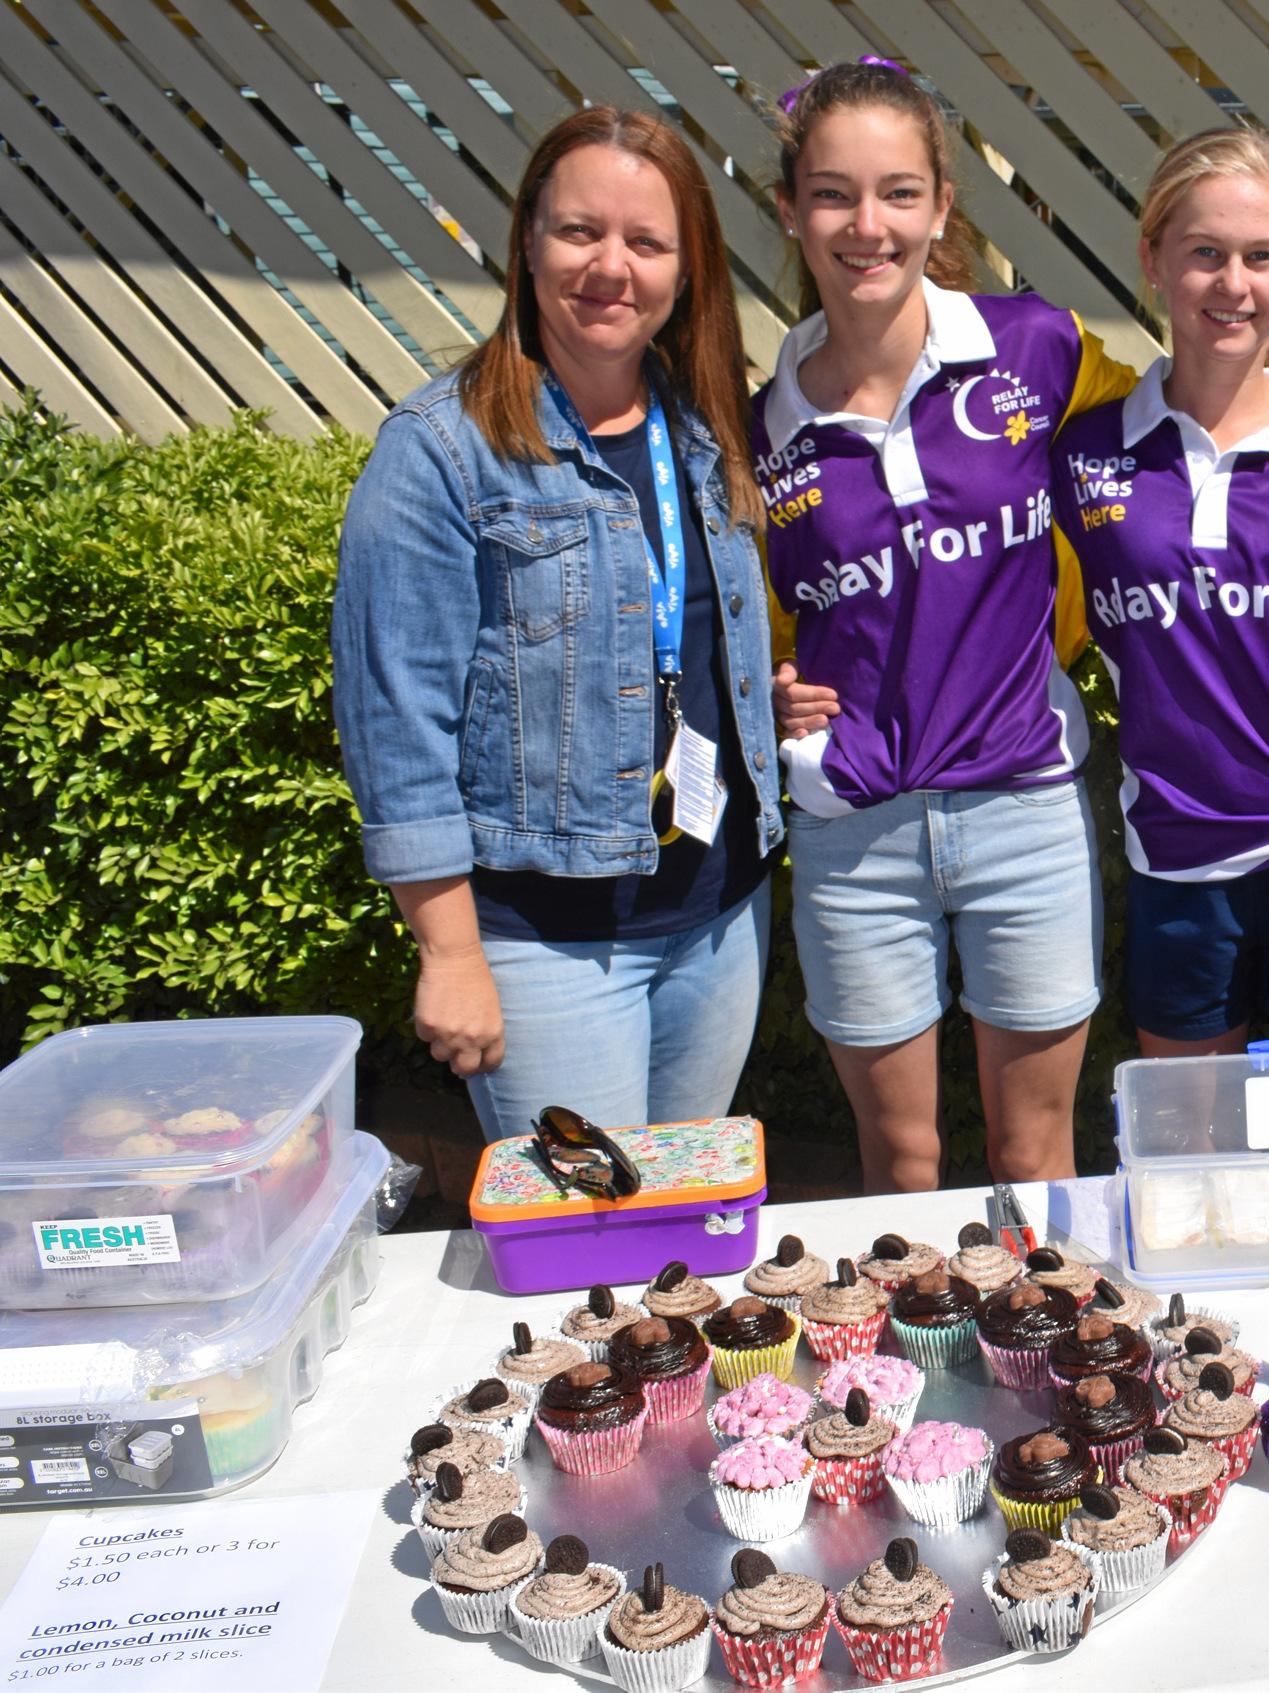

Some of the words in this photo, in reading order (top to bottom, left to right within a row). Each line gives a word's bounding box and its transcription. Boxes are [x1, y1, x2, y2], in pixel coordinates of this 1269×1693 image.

[991, 386, 1028, 404] RELAY
[994, 400, 1018, 415] FOR
[1020, 395, 1041, 408] LIFE
[754, 436, 817, 480] Hope
[1067, 452, 1137, 479] Hope
[760, 461, 821, 507] Lives
[1073, 475, 1133, 506] Lives
[768, 487, 823, 529] Here
[1080, 503, 1126, 532] Here
[902, 520, 988, 570] For
[1000, 488, 1051, 549] Life
[40, 1225, 146, 1250] FRESH
[46, 1254, 91, 1264] QUADRANT
[68, 1248, 89, 1256] Quality
[33, 1414, 84, 1424] storage
[87, 1412, 111, 1421] box
[46, 1487, 93, 1495] target.com.au
[79, 1527, 185, 1548] Cupcakes
[66, 1552, 131, 1570] $1.50
[136, 1545, 189, 1561] each
[196, 1543, 221, 1555] or
[226, 1540, 239, 1551] 3
[247, 1538, 281, 1550] for
[56, 1571, 122, 1591] $4.00
[31, 1619, 118, 1638] Lemon,
[128, 1607, 228, 1626] Coconut
[234, 1601, 281, 1615] and
[19, 1632, 154, 1660] condensed
[160, 1626, 216, 1643] milk
[218, 1622, 272, 1637] slice
[7, 1665, 60, 1682] $1.00
[63, 1662, 91, 1673] for
[95, 1660, 105, 1669] a
[112, 1657, 144, 1668] bag
[150, 1652, 169, 1663] of
[173, 1650, 185, 1661] 2
[188, 1648, 243, 1660] slices.
